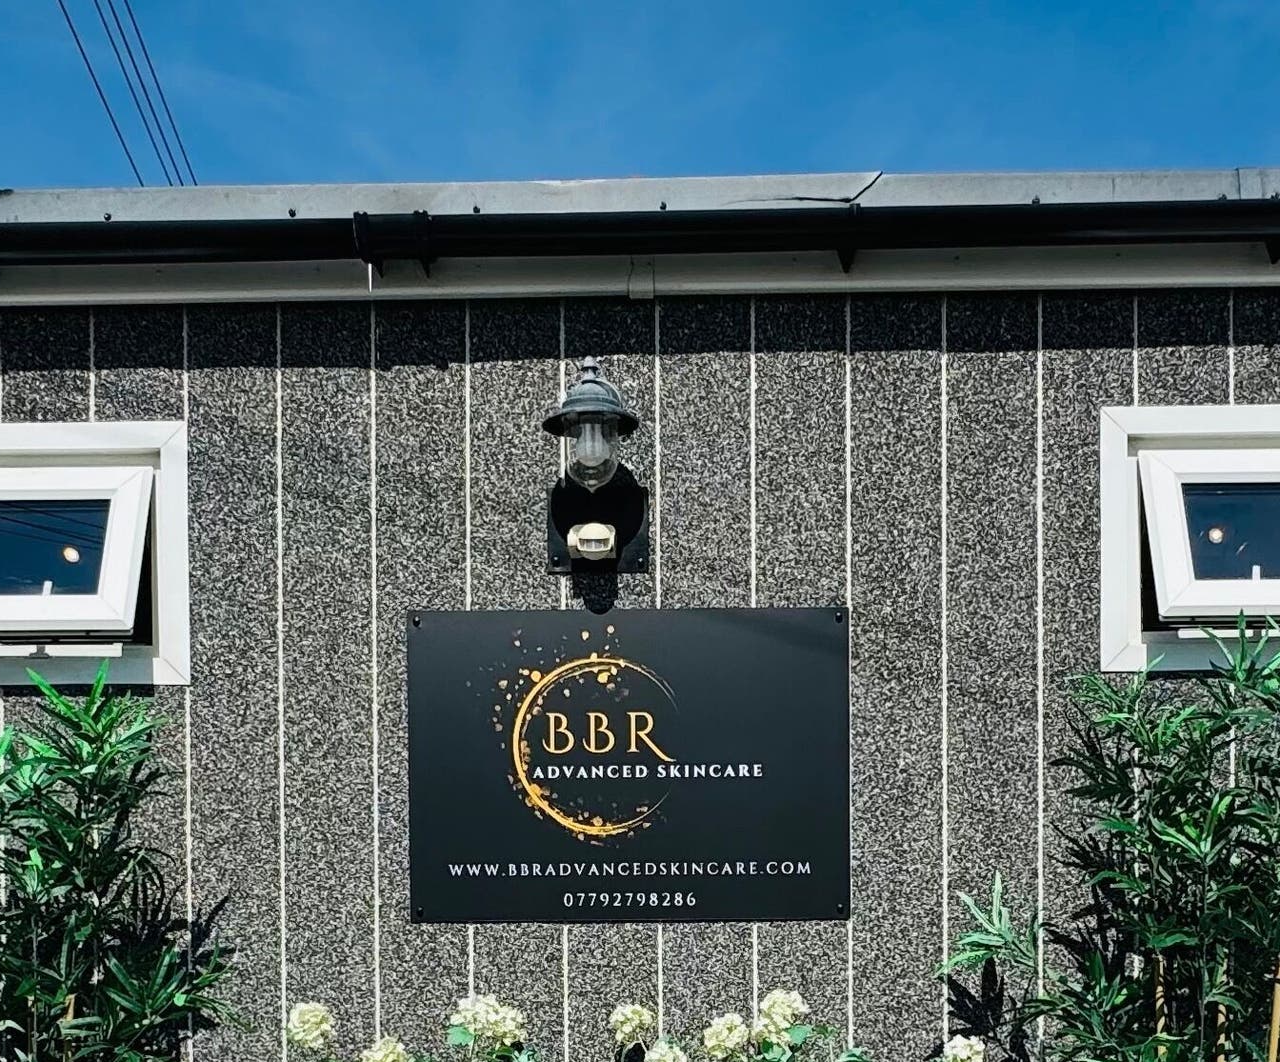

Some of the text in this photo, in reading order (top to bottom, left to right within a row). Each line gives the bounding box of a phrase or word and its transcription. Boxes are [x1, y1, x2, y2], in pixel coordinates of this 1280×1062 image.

[542, 711, 677, 762] BBR
[533, 764, 763, 779] ADVANCED SKINCARE
[449, 861, 811, 877] WWW.BBRADVANCEDSKINCARE.COM
[563, 893, 696, 908] 07792798286
